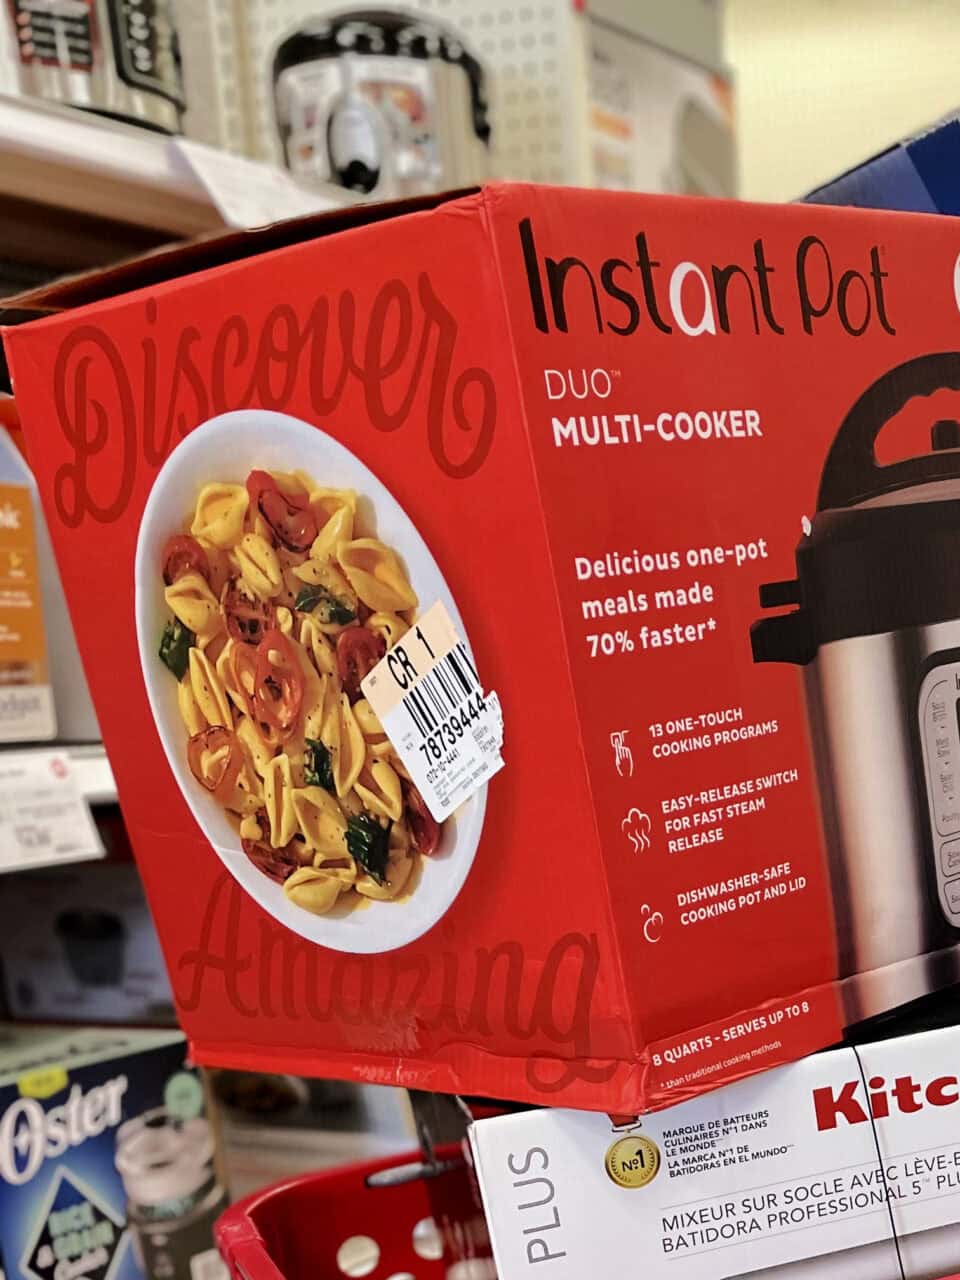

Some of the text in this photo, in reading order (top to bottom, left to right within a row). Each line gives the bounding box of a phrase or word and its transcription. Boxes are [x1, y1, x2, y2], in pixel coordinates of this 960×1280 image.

[518, 217, 896, 337] Instant Pot
[54, 272, 497, 528] Discover
[551, 409, 763, 447] MULTI-COOKER
[575, 538, 768, 580] Delicious one-pot
[581, 581, 714, 620] meals made
[386, 625, 435, 690] CR 1
[586, 630, 635, 658] 70%
[419, 691, 488, 767] 78739444
[649, 707, 743, 738] 13 ONE-TOUCH
[652, 720, 779, 758] COOKING PROGRAMS
[661, 768, 799, 815] EASY-RELEASE SWITCH
[664, 797, 766, 834] FOR FAST STEAM
[668, 828, 725, 854] RELEASE
[677, 862, 792, 907] DISHWASHER-SAFE
[680, 876, 807, 925] COOKING POT AND LID
[178, 868, 618, 1094] Amazing
[652, 1053, 662, 1066] 8
[663, 1035, 713, 1062] QUARTS
[722, 1017, 767, 1042] SERVES
[768, 1009, 784, 1025] UP
[785, 1004, 800, 1017] TO
[801, 1001, 810, 1013] 8
[666, 1040, 783, 1089] than traditional cooking methods
[0, 1074, 128, 1185] Oster
[663, 1110, 770, 1139] MARQUE DE BATTEURS
[664, 1131, 720, 1148] CULINAIRES
[741, 1120, 768, 1132] DANS
[666, 1141, 717, 1157] LE MONDE
[667, 1160, 680, 1169] LA
[682, 1152, 716, 1166] MARCA
[737, 1144, 750, 1154] DE
[669, 1146, 788, 1178] BATIDORAS EN EL MUNDO
[508, 1147, 567, 1264] PLUS
[662, 1201, 737, 1233] MIXEUR
[742, 1192, 778, 1215] SUR
[783, 1177, 844, 1205] SOCLE
[849, 1165, 899, 1191] AVEC
[662, 1217, 762, 1253] BATIDORA
[767, 1183, 908, 1230] PROFESSIONAL
